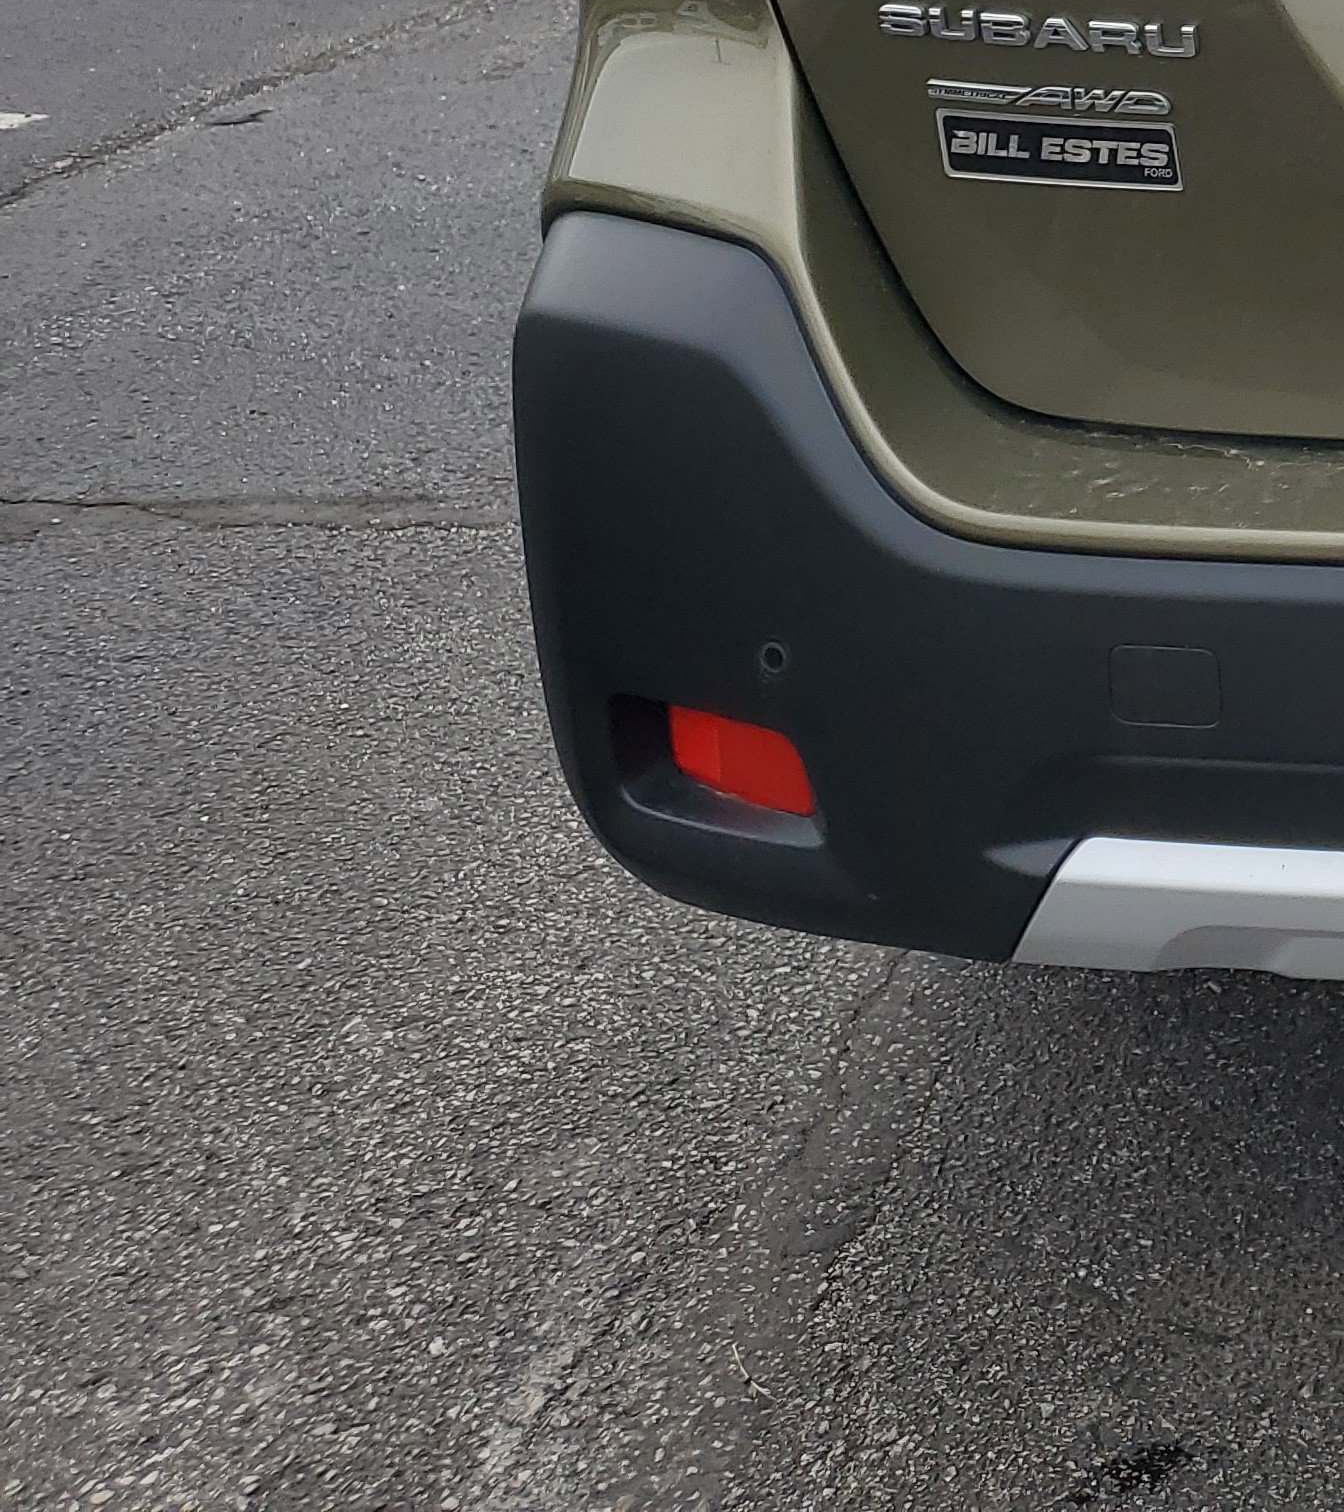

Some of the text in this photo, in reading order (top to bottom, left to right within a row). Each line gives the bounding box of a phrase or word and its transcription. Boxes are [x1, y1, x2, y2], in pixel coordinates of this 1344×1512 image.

[878, 3, 1200, 59] SUBARU
[1015, 86, 1172, 116] AWD
[951, 130, 1170, 167] BILL ESTES
[1143, 167, 1173, 178] FORD
